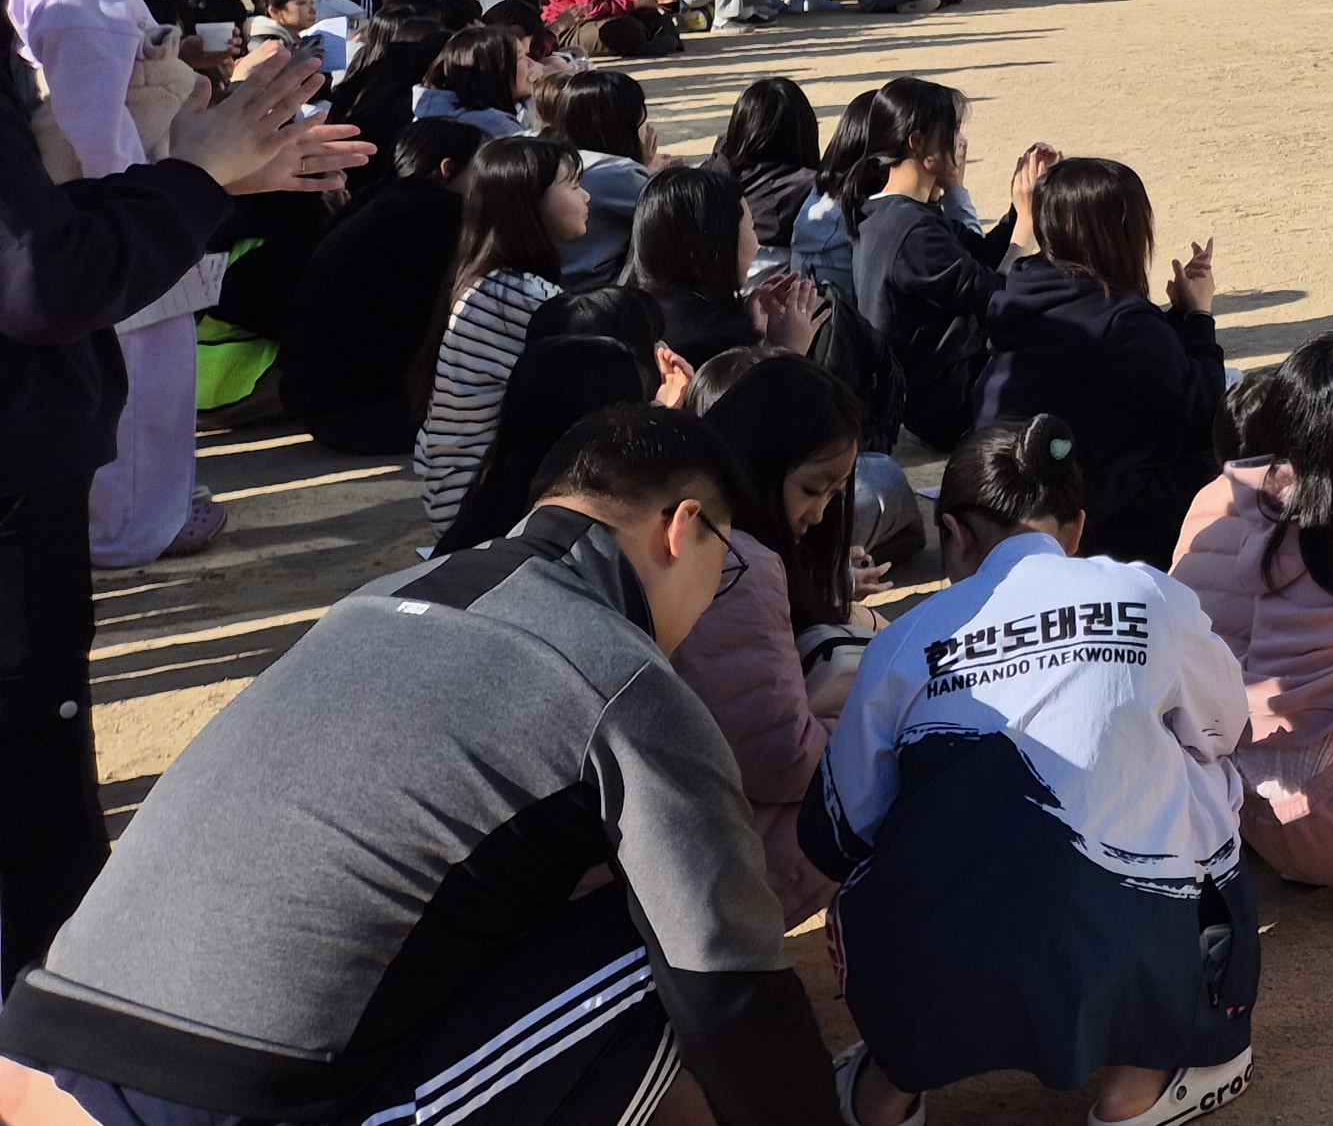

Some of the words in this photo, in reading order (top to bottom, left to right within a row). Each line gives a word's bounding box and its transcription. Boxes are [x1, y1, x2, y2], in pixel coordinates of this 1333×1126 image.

[923, 601, 1149, 677] 한반도태권도
[926, 659, 1030, 700] HANBANDO
[1035, 646, 1147, 671] TAEKWONDO
[1200, 1053, 1255, 1111] croc
